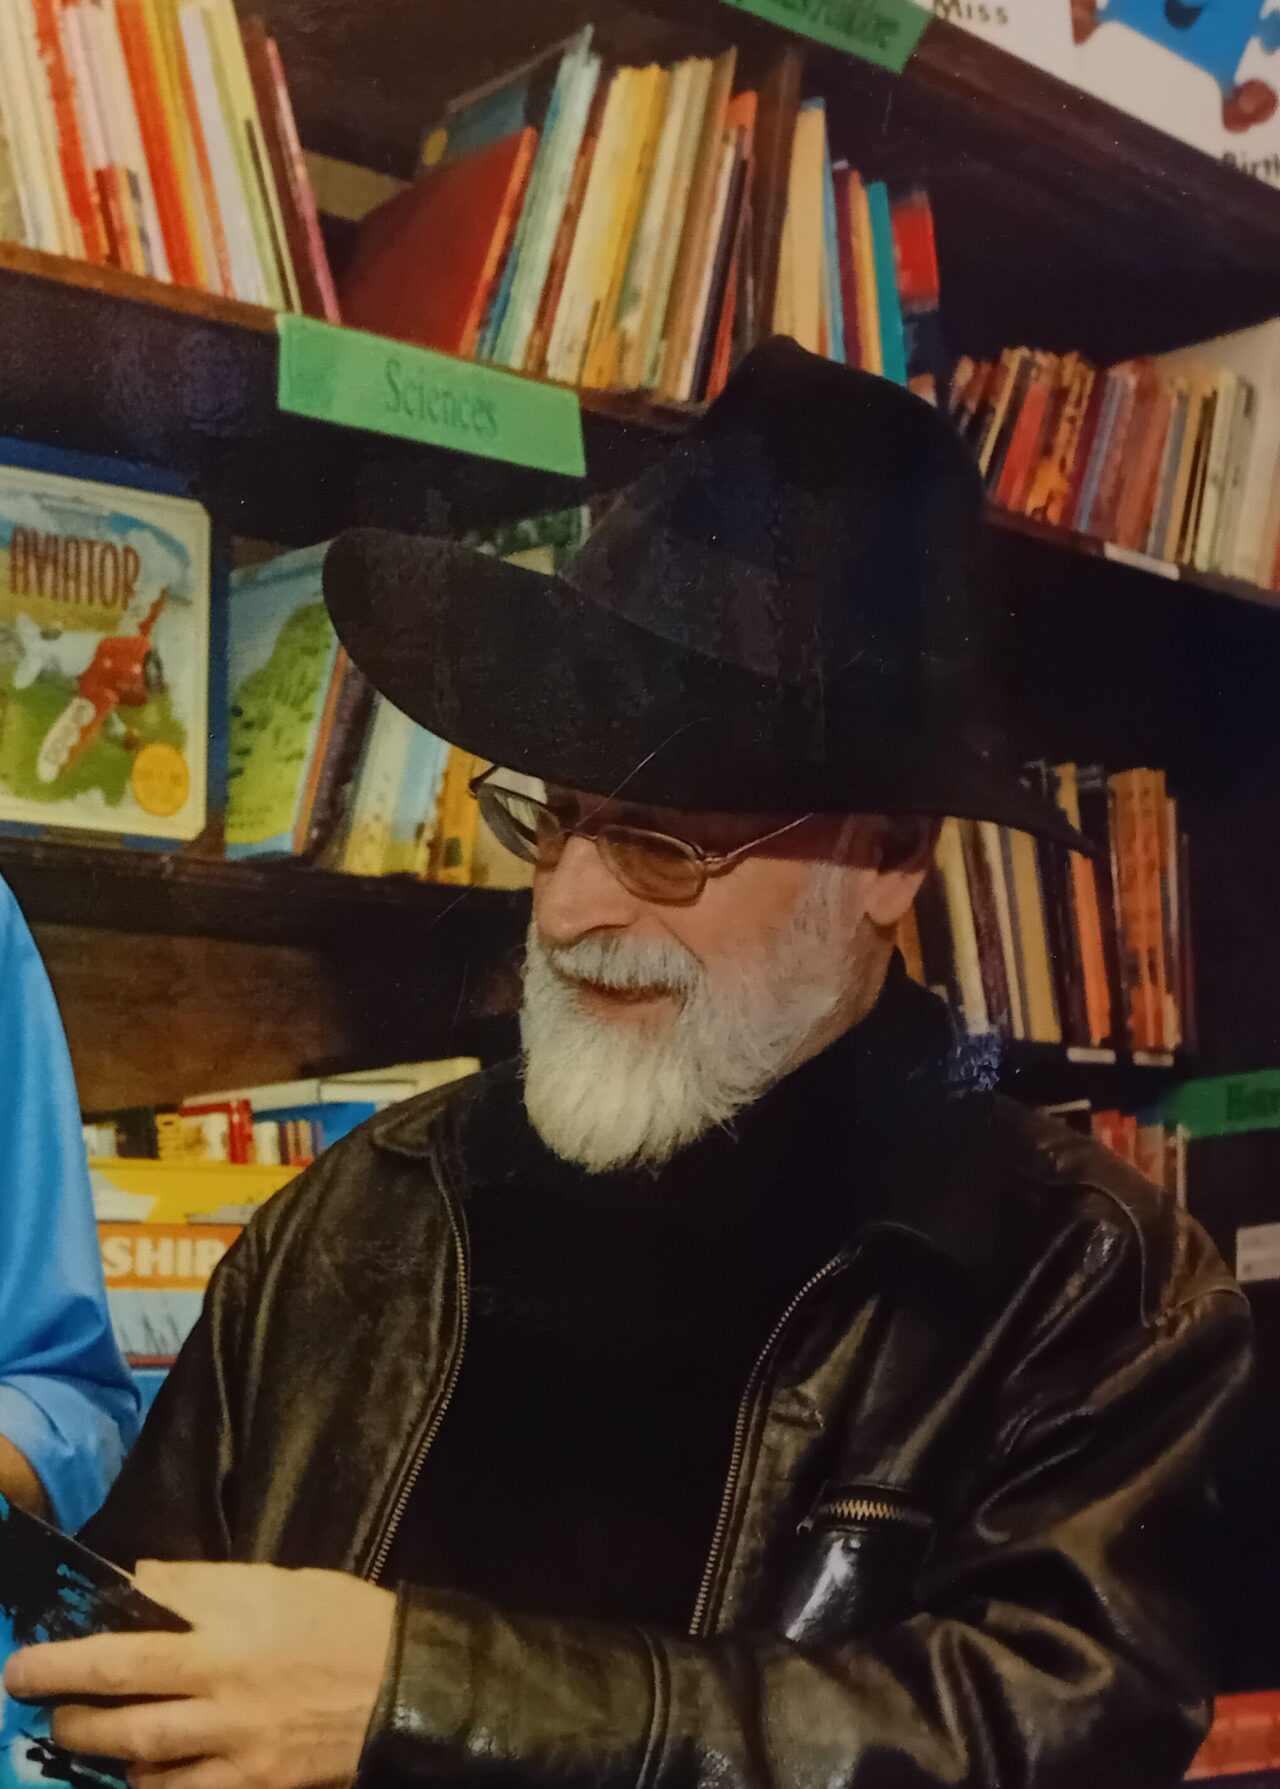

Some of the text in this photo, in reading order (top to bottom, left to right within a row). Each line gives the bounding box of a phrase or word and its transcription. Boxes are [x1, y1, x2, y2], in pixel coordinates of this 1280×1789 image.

[933, 0, 1009, 24] Miss
[384, 358, 499, 439] Sciences
[9, 525, 141, 611] AVIATOR
